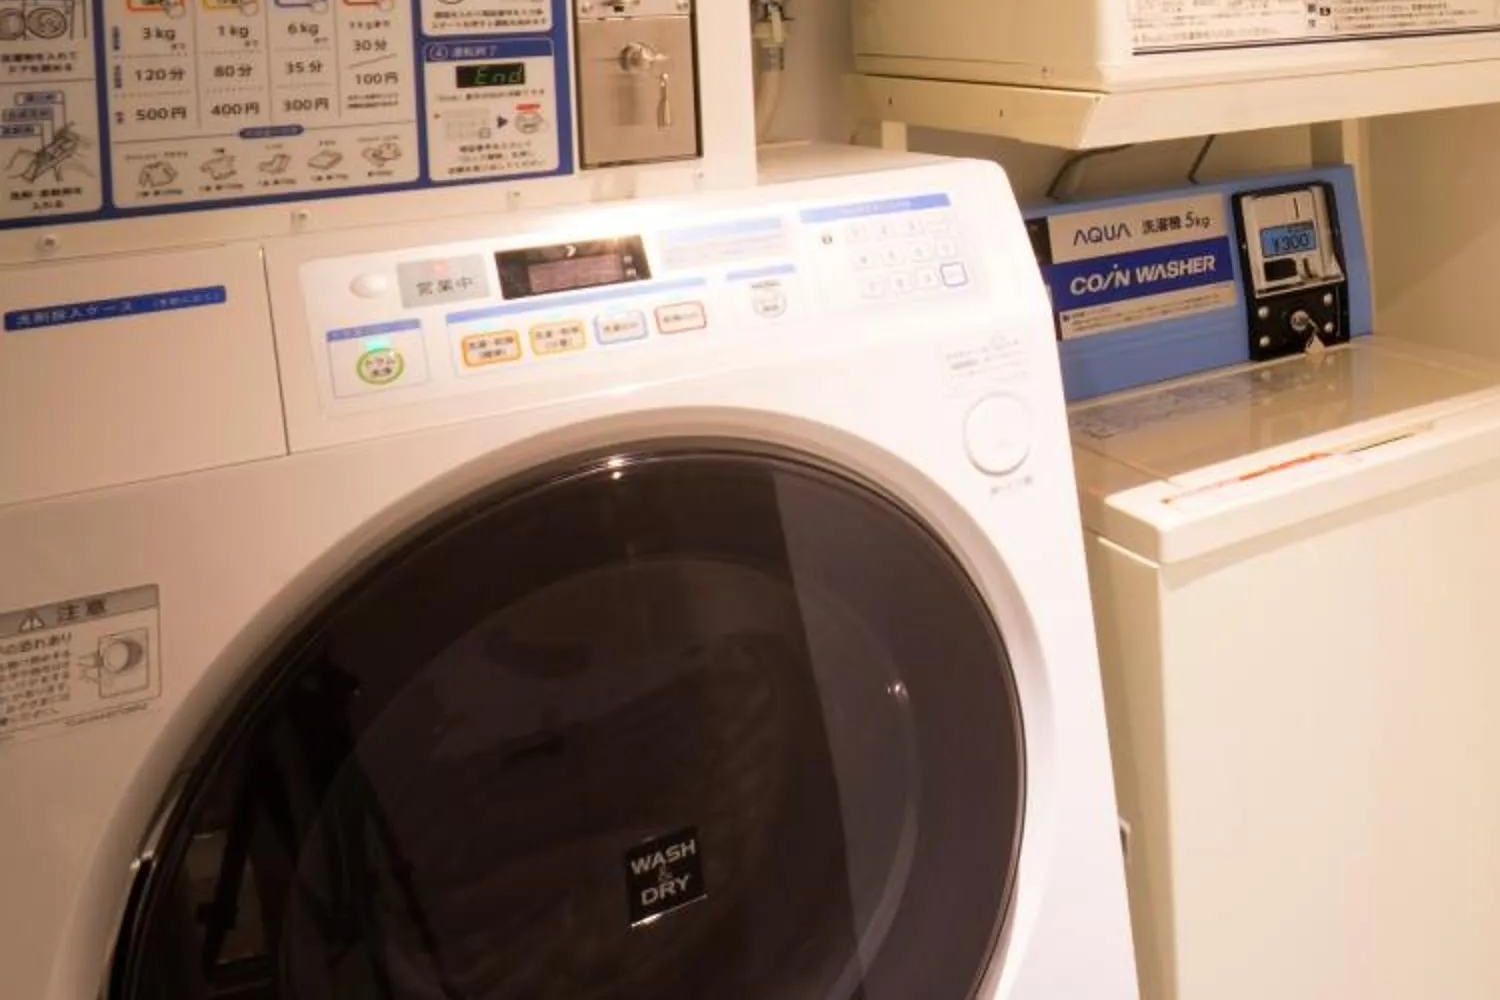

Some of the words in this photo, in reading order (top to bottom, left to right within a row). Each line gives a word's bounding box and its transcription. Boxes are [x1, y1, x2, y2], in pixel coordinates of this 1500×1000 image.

[134, 67, 186, 82] 120分
[213, 63, 253, 79] 80分
[285, 59, 323, 74] 35分
[355, 72, 399, 86] 100円
[473, 66, 524, 85] End
[135, 106, 188, 122] 500円
[210, 101, 261, 117] 400円
[284, 97, 330, 113] 300円
[1072, 222, 1133, 247] AQUA
[1141, 216, 1182, 236] 洗濯機
[1184, 211, 1212, 232] 5kg
[414, 276, 474, 297] 営業中
[1069, 263, 1132, 296] COIN
[1135, 254, 1217, 286] WASHER
[630, 839, 697, 875] WASH
[641, 873, 691, 906] DRY
